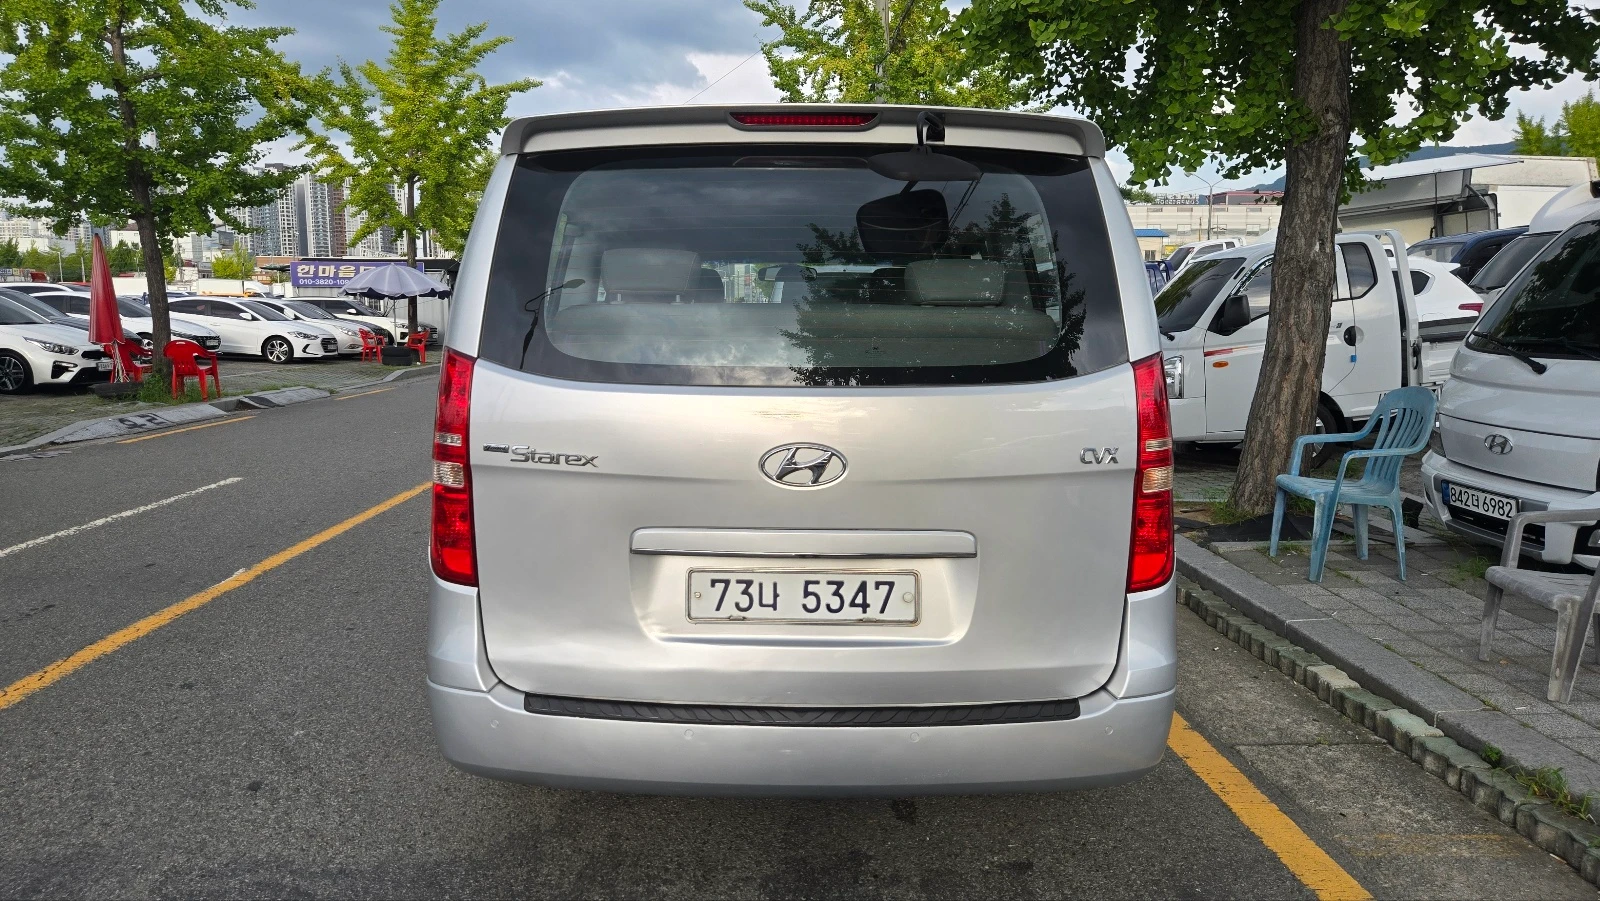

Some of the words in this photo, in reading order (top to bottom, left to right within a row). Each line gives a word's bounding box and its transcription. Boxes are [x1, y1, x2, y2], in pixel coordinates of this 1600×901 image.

[510, 445, 599, 468] Starex
[1080, 447, 1119, 464] CVX
[1450, 486, 1480, 509] 842더
[1482, 496, 1513, 518] 6982
[710, 578, 780, 612] 73나
[801, 579, 896, 614] 5347
